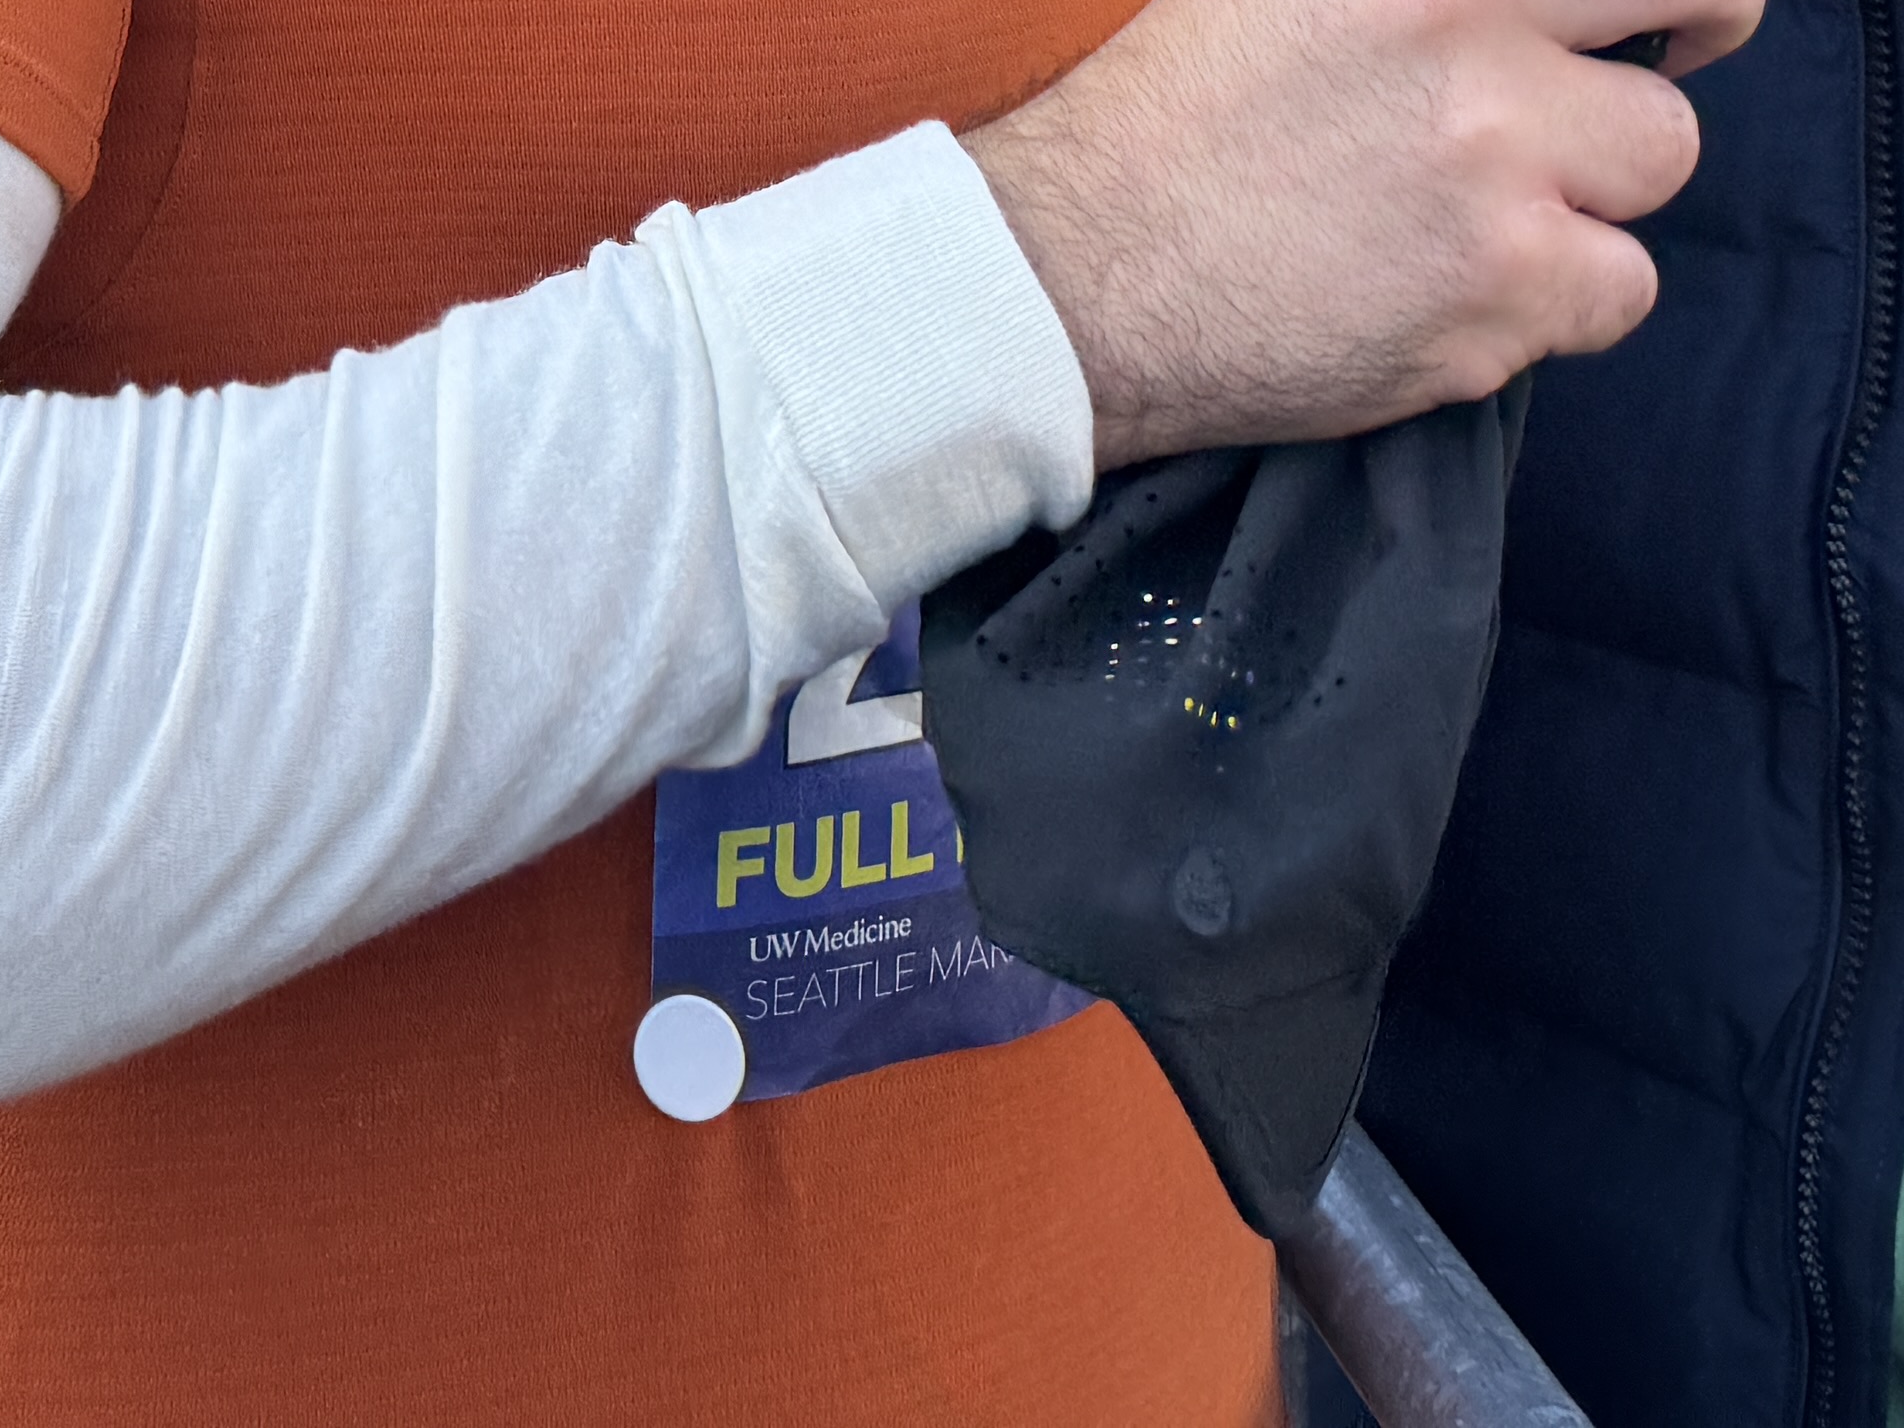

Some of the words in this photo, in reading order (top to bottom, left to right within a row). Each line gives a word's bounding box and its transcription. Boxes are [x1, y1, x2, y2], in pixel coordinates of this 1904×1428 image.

[716, 800, 934, 908] FULL
[749, 931, 801, 962] UW
[803, 915, 912, 957] Medicine
[746, 951, 918, 1020] SEATTLE
